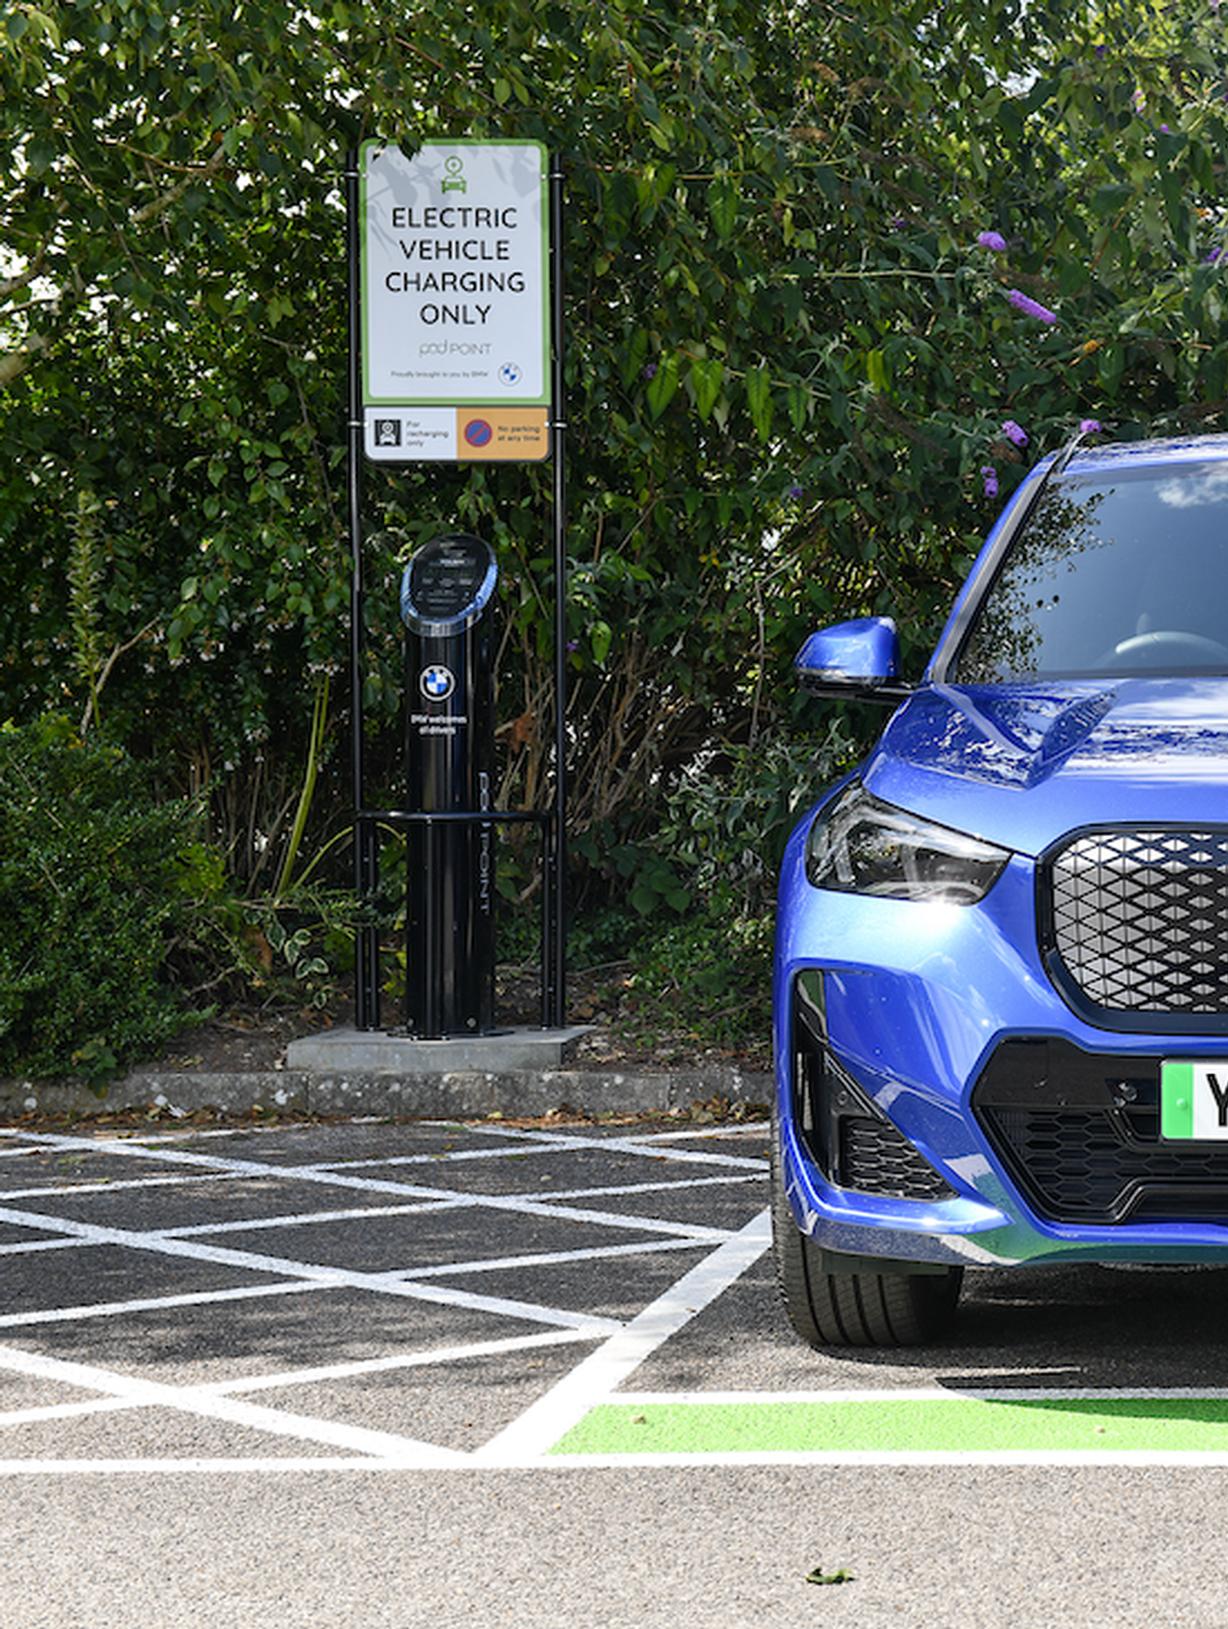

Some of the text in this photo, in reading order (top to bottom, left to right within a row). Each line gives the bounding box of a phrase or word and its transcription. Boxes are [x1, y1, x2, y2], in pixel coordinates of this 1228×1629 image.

[392, 207, 518, 228] ELECTRIC
[399, 239, 510, 260] VEHICLE
[385, 272, 526, 293] CHARGING
[420, 303, 492, 325] ONLY
[419, 339, 493, 359] pod POINT
[406, 430, 449, 439] recharging
[507, 435, 521, 443] any
[511, 425, 540, 435] parking
[406, 440, 424, 449] only
